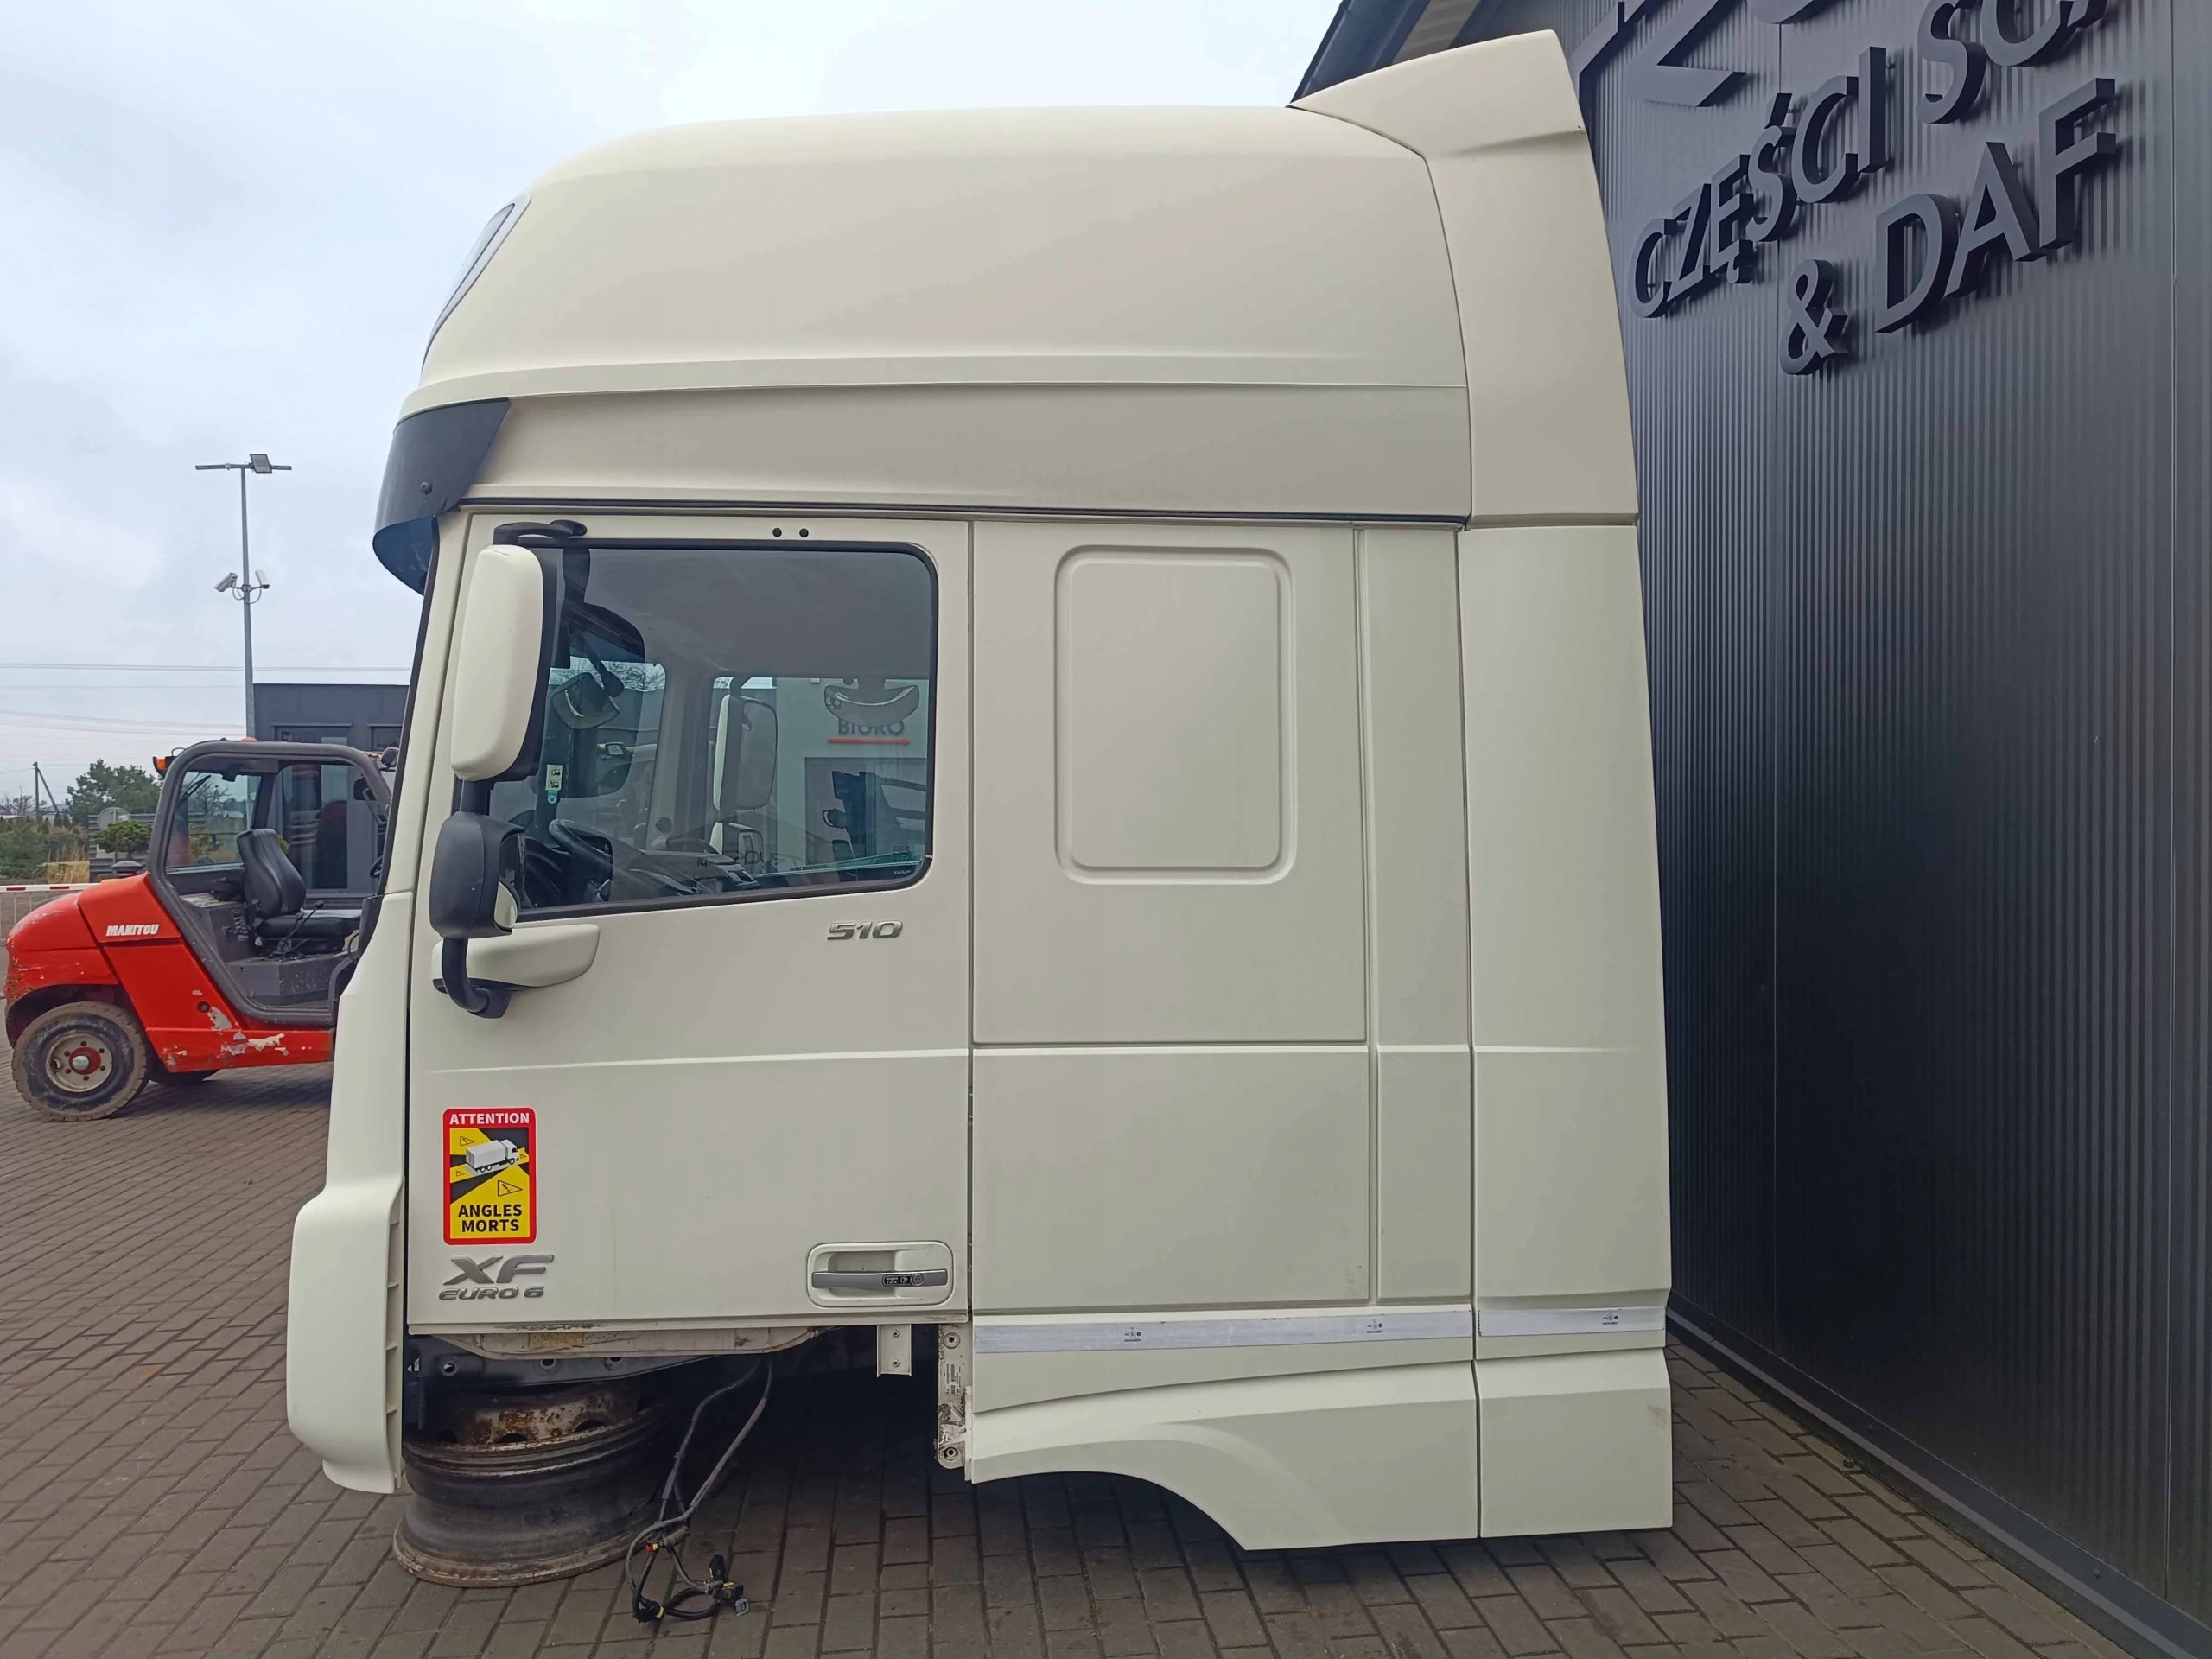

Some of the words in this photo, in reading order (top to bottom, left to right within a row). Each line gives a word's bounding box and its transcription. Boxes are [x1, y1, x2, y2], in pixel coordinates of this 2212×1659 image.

[1631, 47, 1887, 318] CZĘŚCI
[1781, 260, 1848, 375] &
[1875, 78, 2116, 334] DAF
[105, 924, 160, 937] MANITOU
[827, 920, 903, 940] 510
[449, 1112, 530, 1125] ATTENTION
[458, 1204, 523, 1218] ANGLES
[461, 1218, 520, 1233] MORTS
[443, 1255, 555, 1286] XF
[439, 1287, 520, 1300] EURO
[524, 1286, 544, 1298] 6
